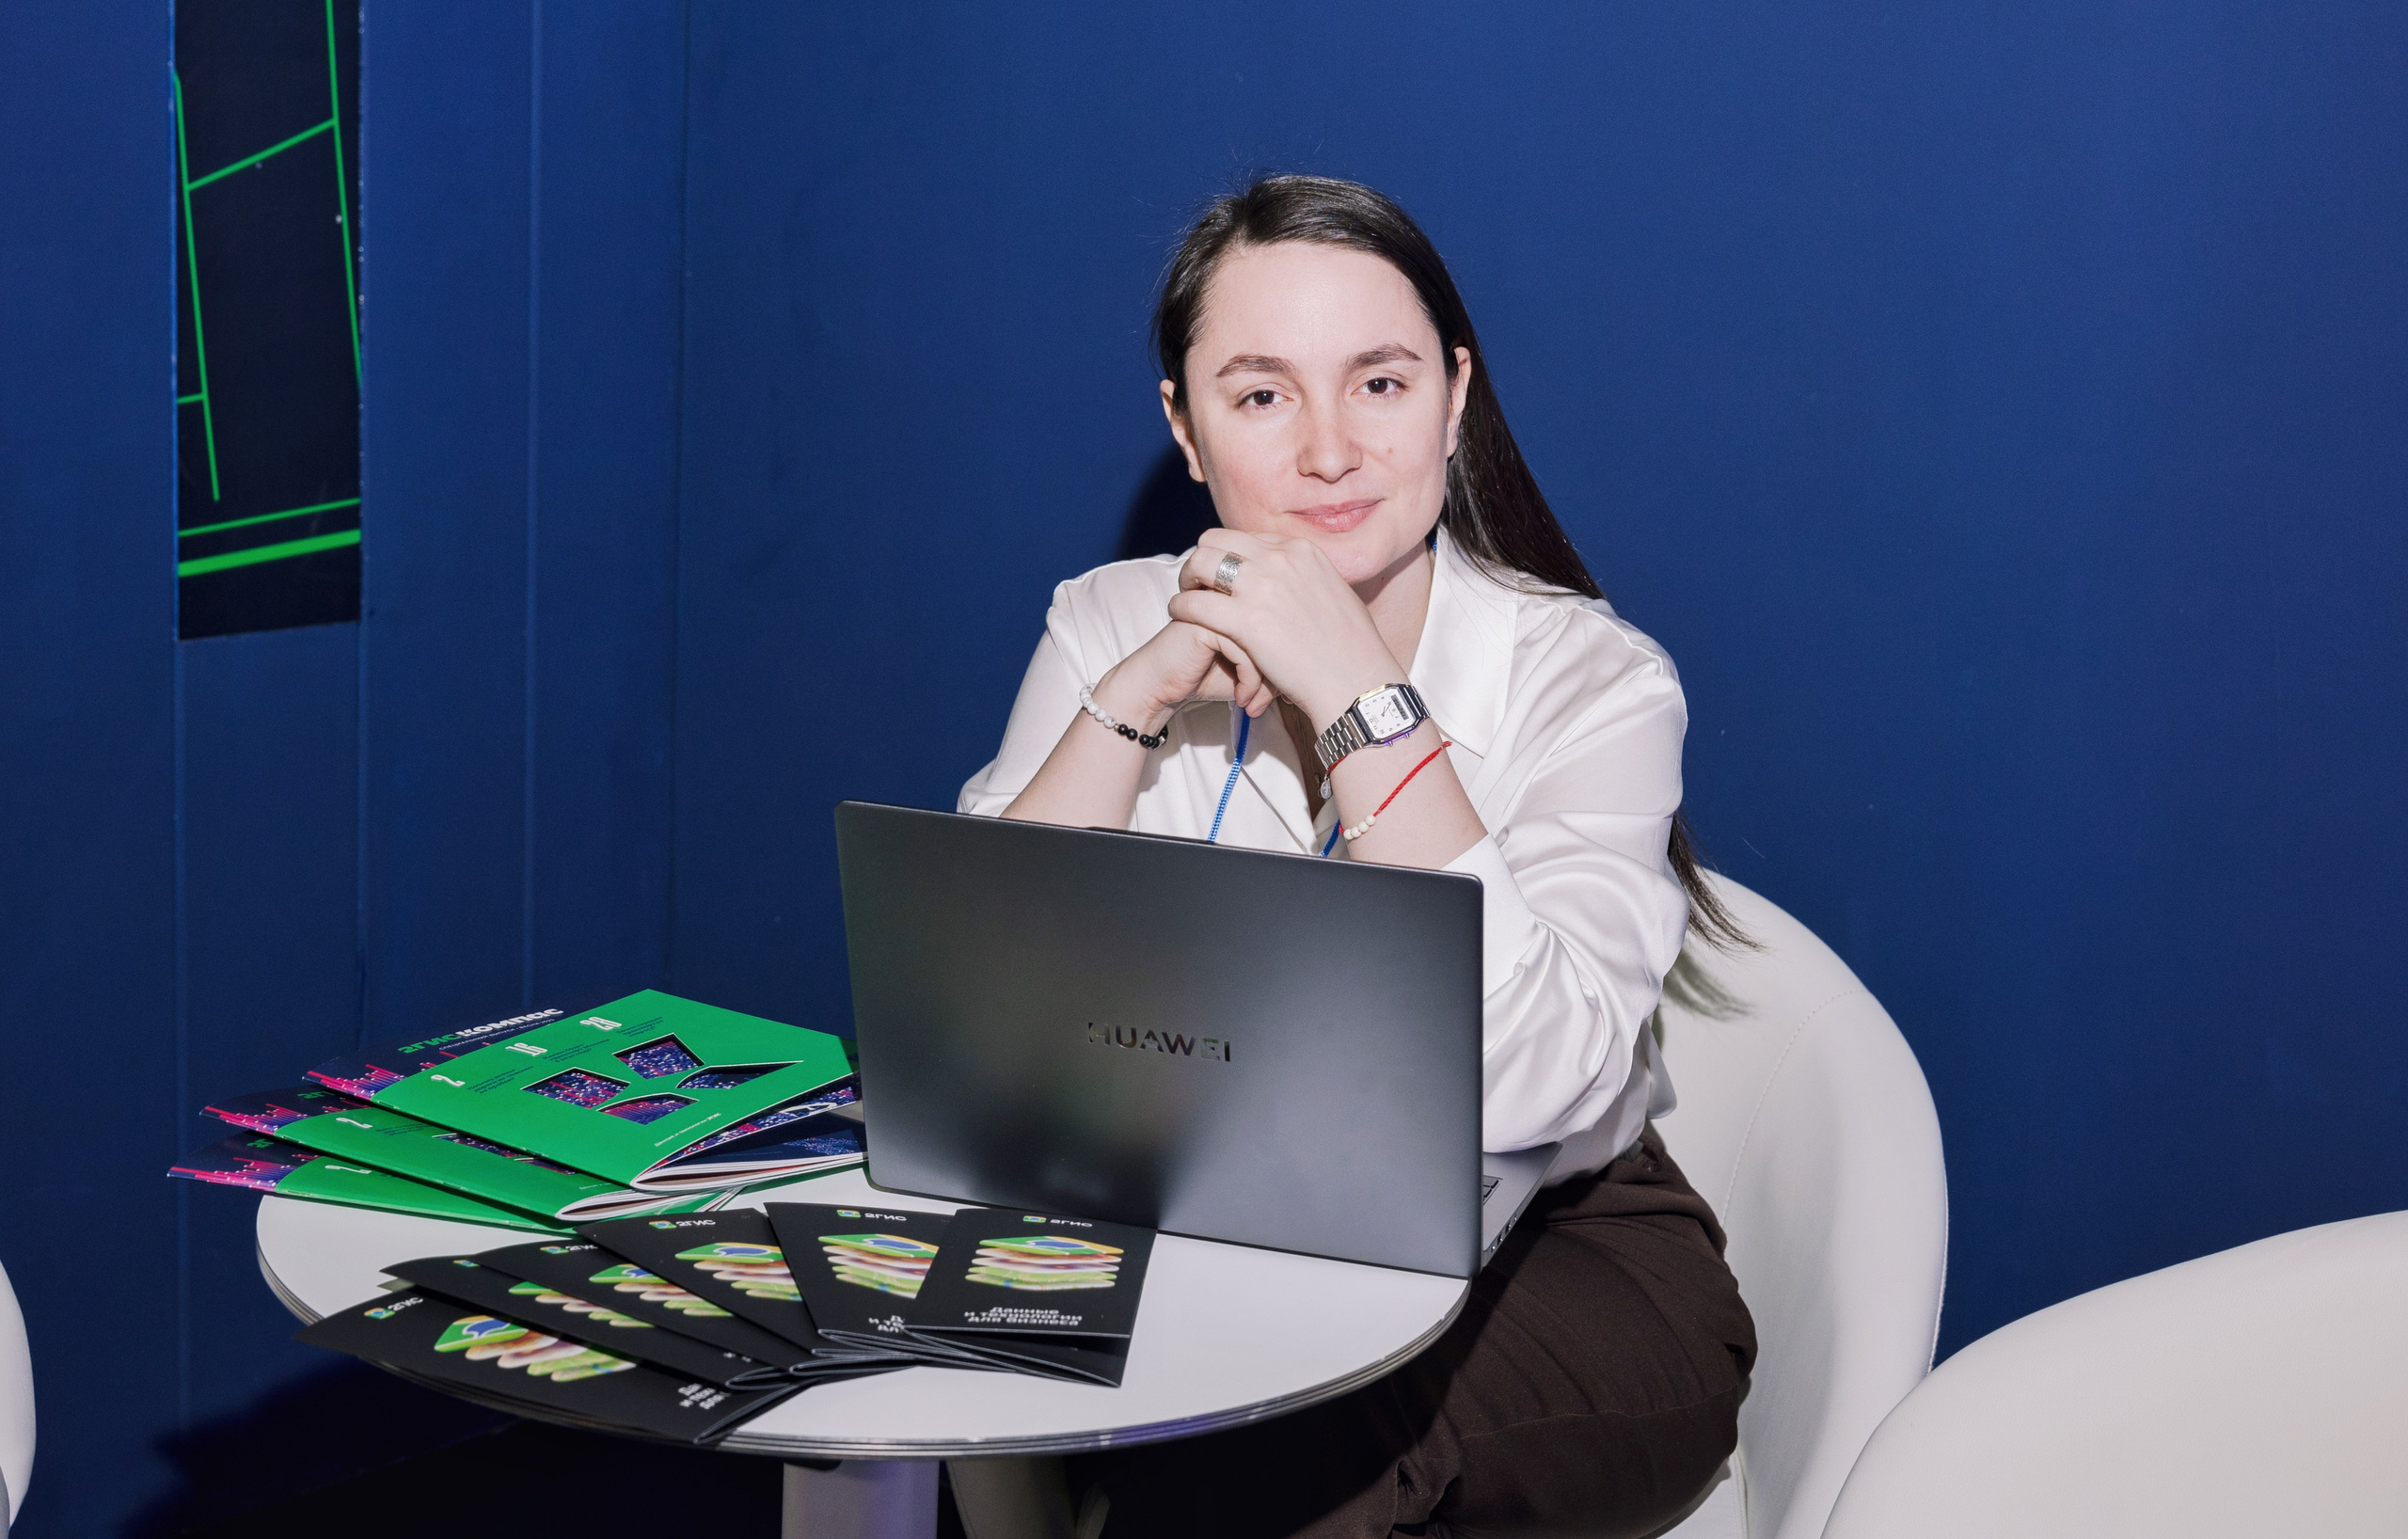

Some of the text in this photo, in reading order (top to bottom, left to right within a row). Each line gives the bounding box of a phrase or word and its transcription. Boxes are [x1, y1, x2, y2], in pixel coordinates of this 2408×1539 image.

[578, 1016, 622, 1031] 28
[504, 1042, 547, 1056] 16
[1088, 1022, 1231, 1062] HUAWEI
[430, 1074, 466, 1087] 2
